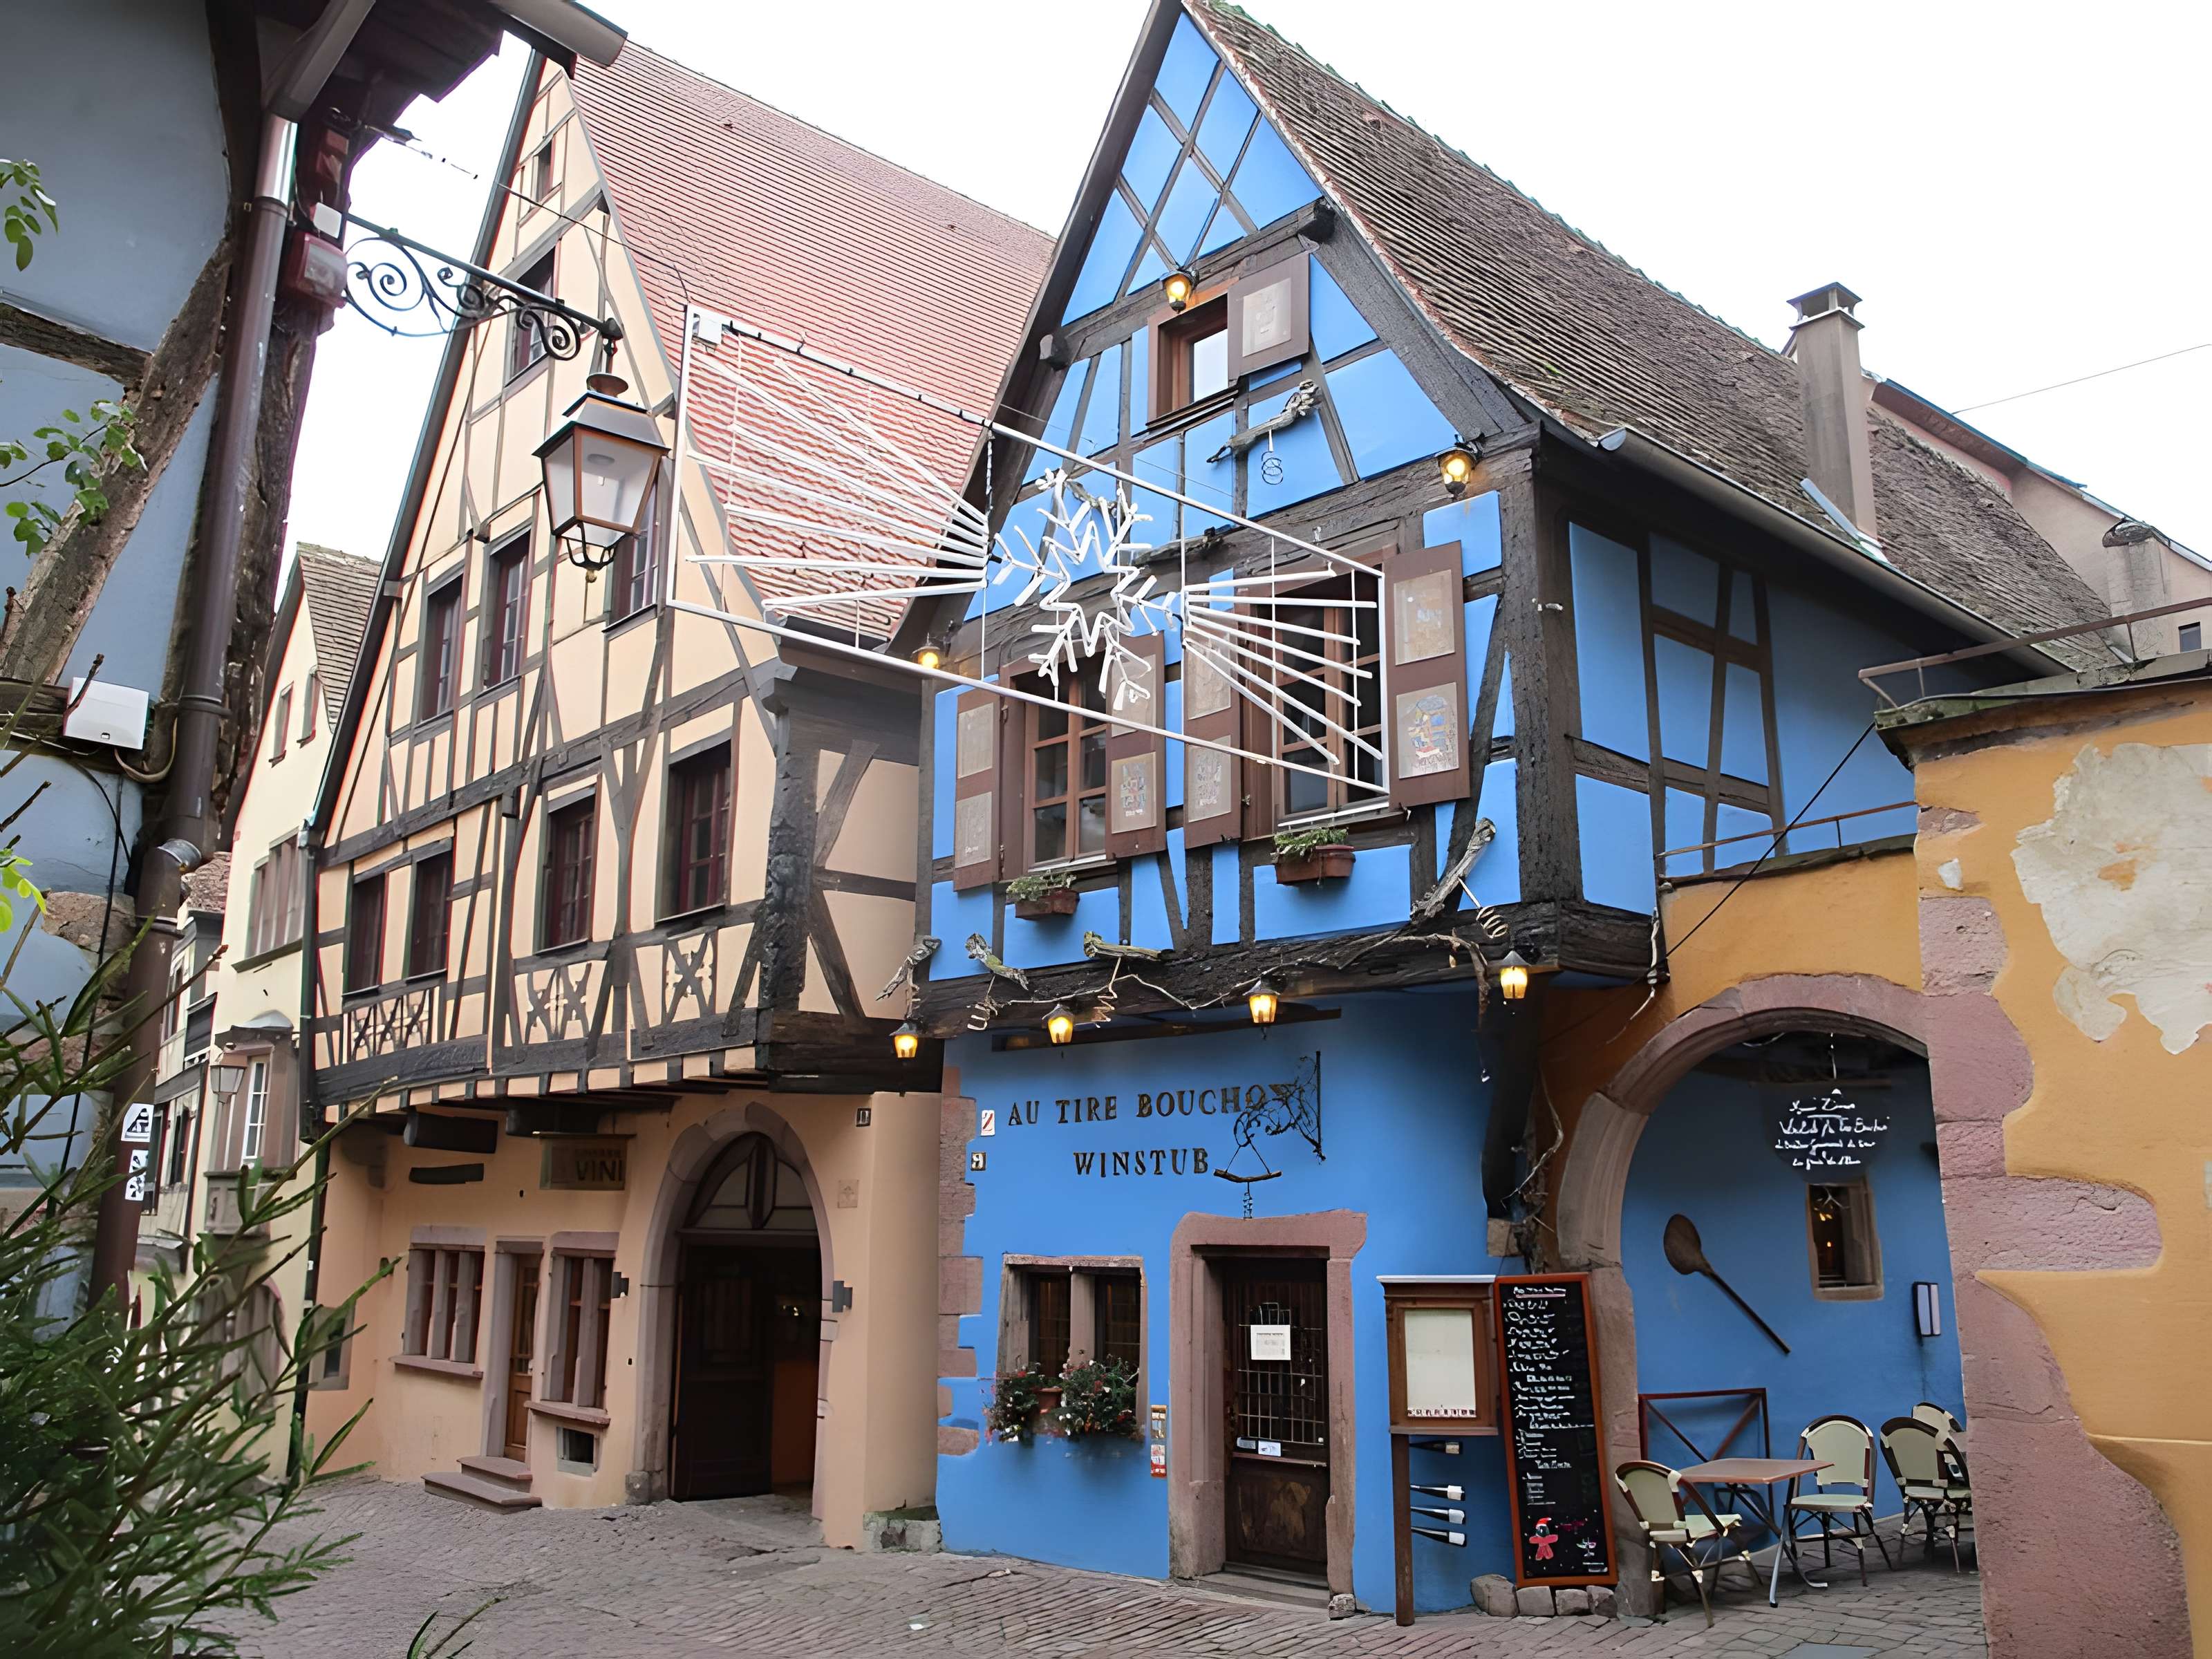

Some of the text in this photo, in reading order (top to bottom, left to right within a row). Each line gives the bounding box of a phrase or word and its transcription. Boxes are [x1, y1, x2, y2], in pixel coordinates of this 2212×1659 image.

[1008, 1100, 1040, 1126] AU
[1056, 1096, 1117, 1123] TIRE
[1074, 1147, 1208, 1177] WINSTUB
